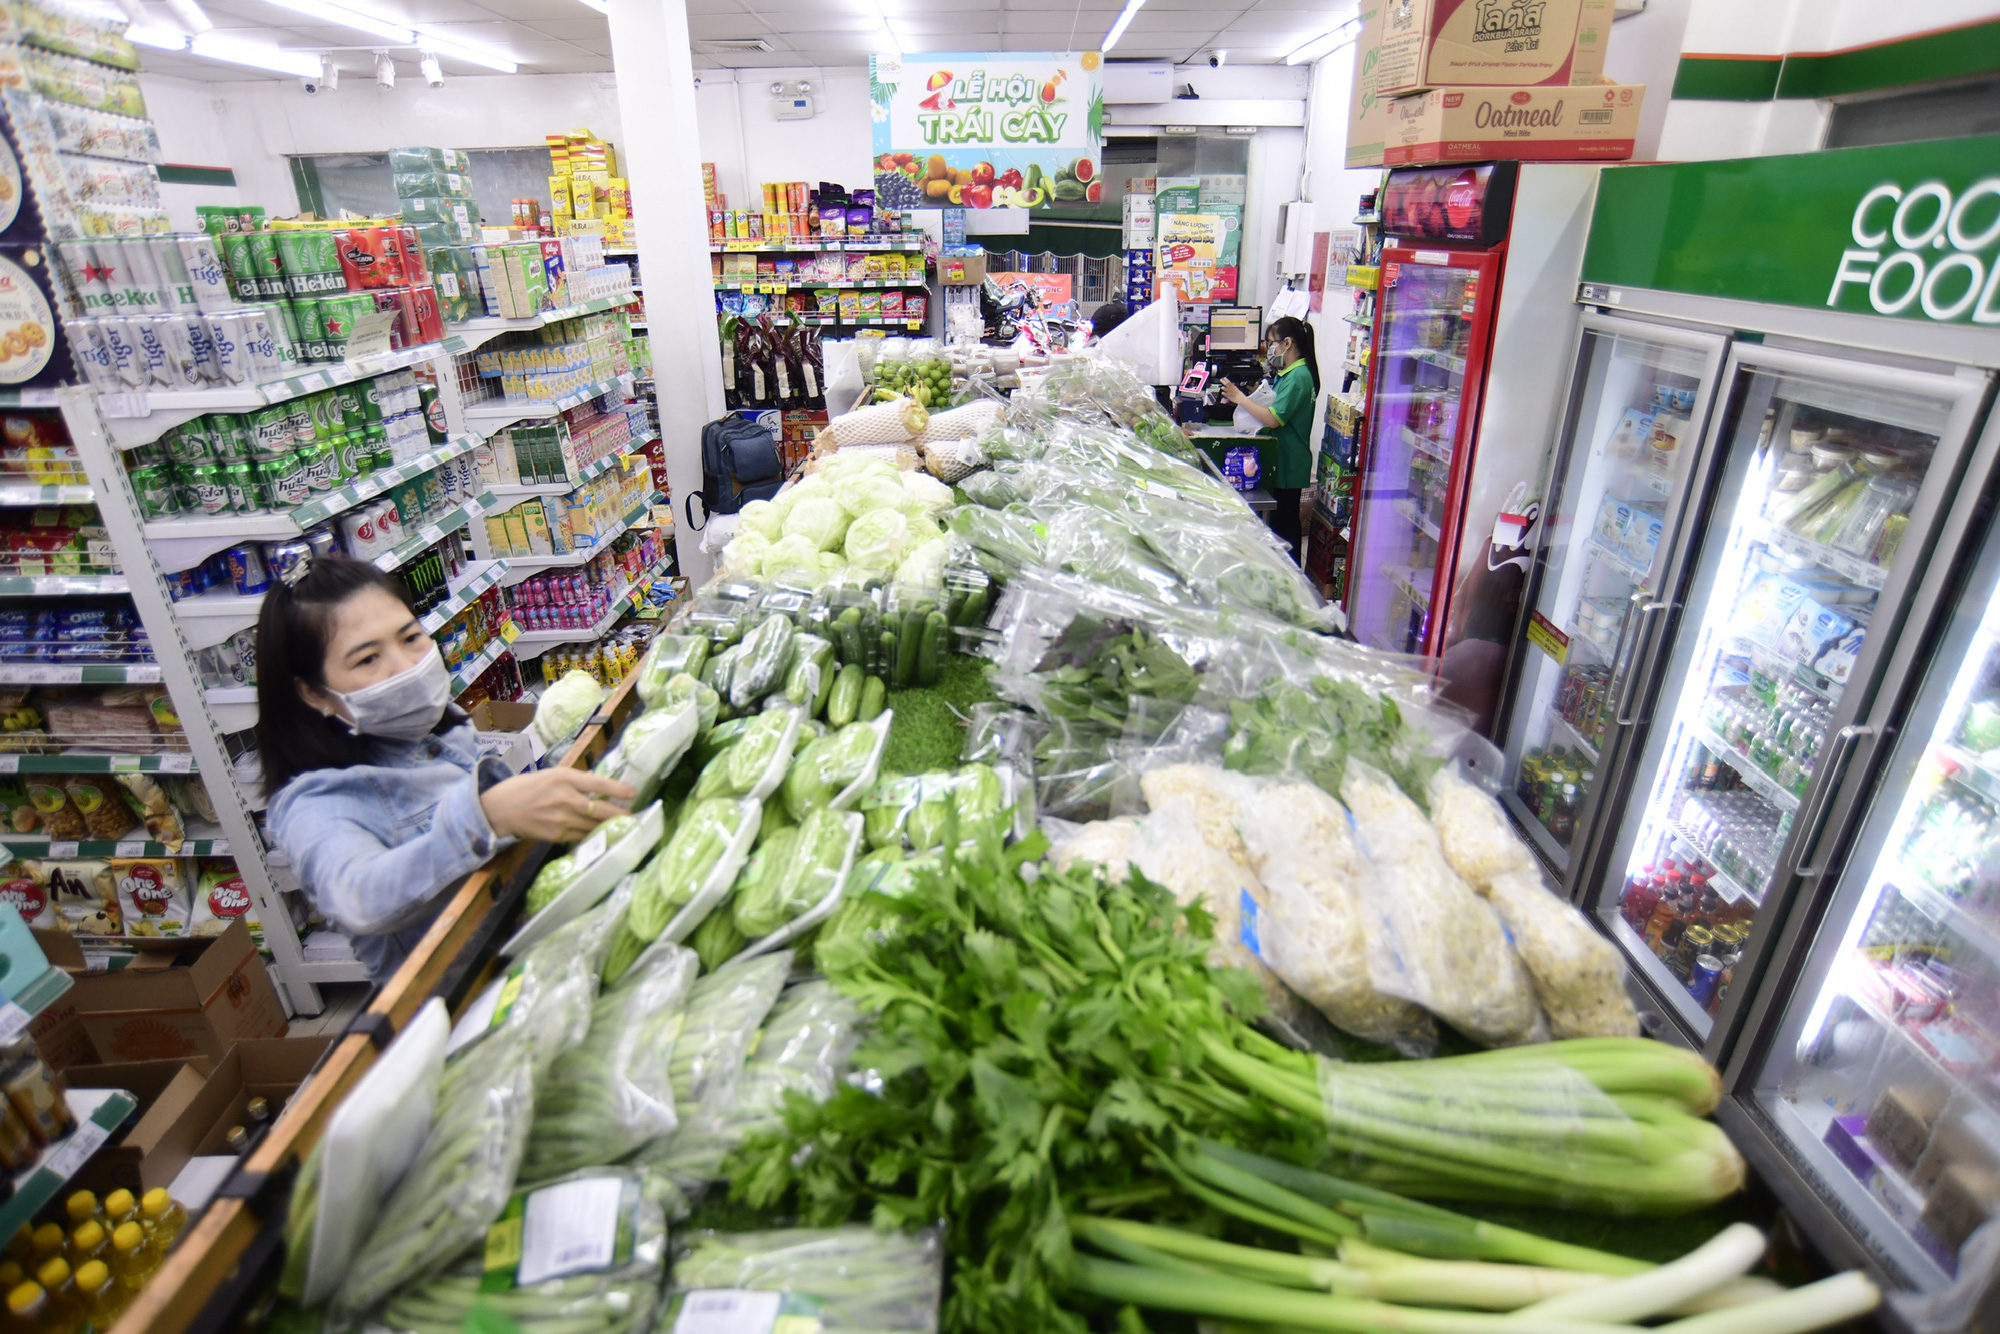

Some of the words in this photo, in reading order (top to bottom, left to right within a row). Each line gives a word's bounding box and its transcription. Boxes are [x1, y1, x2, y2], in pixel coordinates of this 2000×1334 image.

[1513, 26, 1542, 38] BRAND
[953, 70, 984, 100] LỄ
[988, 75, 1034, 105] HỘI
[1445, 95, 1463, 103] NEW
[1475, 100, 1563, 129] Oatmeal
[919, 106, 993, 143] TRÁI
[1001, 108, 1067, 142] CÂY
[1503, 130, 1518, 138] Mini
[190, 265, 224, 286] Tige
[246, 340, 276, 358] Tige
[447, 464, 457, 493] Tiger
[459, 458, 471, 489] Tiger
[70, 610, 104, 623] OREO
[51, 867, 94, 901] An
[121, 876, 156, 894] One
[138, 885, 174, 901] One
[213, 886, 242, 899] One
[221, 894, 249, 909] One
